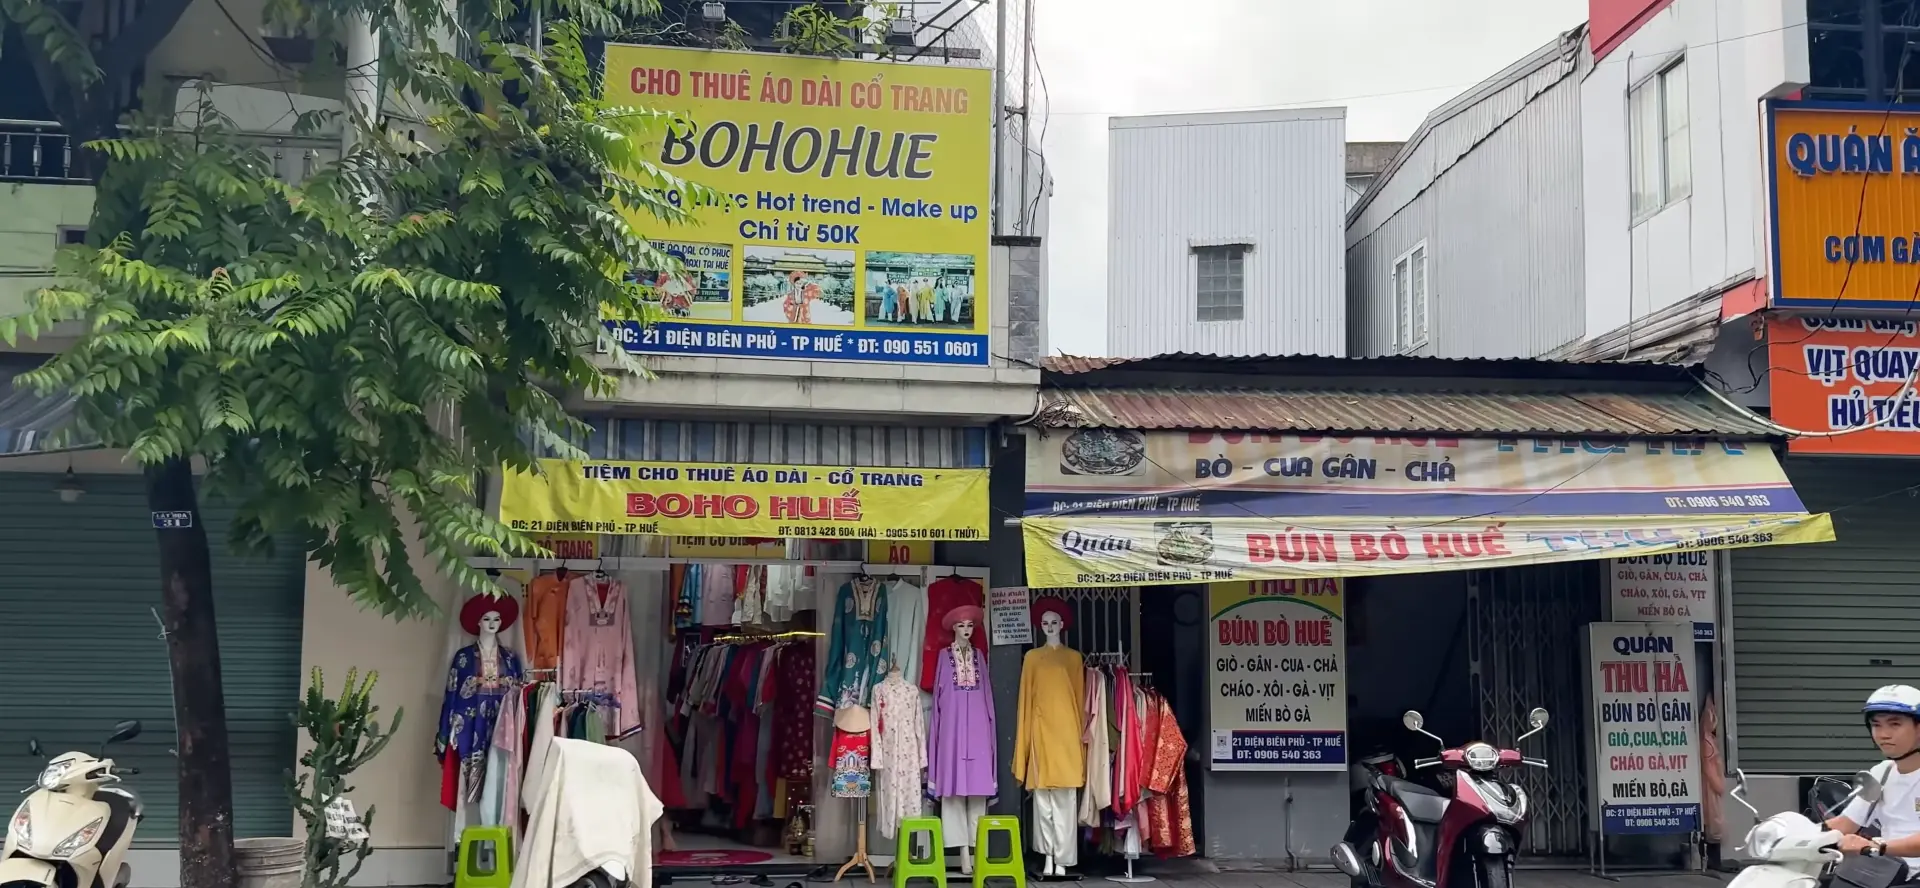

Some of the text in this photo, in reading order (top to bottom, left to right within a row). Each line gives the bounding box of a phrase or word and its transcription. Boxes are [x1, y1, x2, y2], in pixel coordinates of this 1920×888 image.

[630, 66, 969, 115] CHO THUÊ ÁO DÀI CỔ TRANG
[660, 117, 938, 179] BOHOHUE
[1786, 125, 1893, 177] QUÁN
[756, 190, 795, 211] Hot
[802, 193, 861, 215] trend
[882, 197, 942, 219] Make
[950, 204, 978, 223] up
[739, 218, 860, 244] Chỉ từ 50K
[1824, 233, 1885, 263] CƠM
[642, 330, 660, 345] 21
[666, 328, 702, 349] ĐIỆN
[707, 331, 740, 348] BIÊN
[747, 330, 777, 350] PHỦ
[791, 336, 809, 351] TP
[814, 333, 844, 353] HUẾ
[858, 338, 879, 354] ĐT:
[883, 339, 910, 355] 090
[914, 340, 939, 356] 551
[944, 341, 978, 357] 0601
[1807, 349, 1919, 382] VỊT QUAY
[1831, 389, 1866, 426] HỦ
[583, 464, 923, 487] TIỆM CHO THUÊ ÁO DÀI CỔ TRANG
[1195, 453, 1456, 482] BÒ CUA GÂN CHẢ
[626, 487, 863, 521] BOHO HUẾ
[1167, 497, 1178, 512] TP
[1686, 496, 1719, 508] 0906
[1719, 495, 1745, 507] 540
[1745, 494, 1770, 506] 363
[512, 520, 528, 531] ĐC:
[531, 520, 542, 531] 21
[546, 519, 569, 533] ĐIỆN
[571, 519, 593, 531] BIÊN
[625, 523, 636, 532] TP
[640, 521, 658, 533] HUẾ
[778, 526, 792, 535] ĐT:
[794, 526, 817, 536] 0813
[819, 527, 836, 536] 428
[839, 527, 855, 537] 604
[858, 527, 877, 538] (HÀ)
[886, 529, 908, 538] 0905
[910, 529, 927, 538] 510
[930, 530, 945, 538] 601
[555, 540, 593, 560] TRANG
[1062, 522, 1512, 562] Quán BÚN BÒ HUẾ
[1727, 534, 1749, 545] 540
[1752, 532, 1773, 543] 363
[1095, 573, 1121, 583] 21-23
[1200, 571, 1212, 580] TP
[1214, 568, 1233, 579] HUẾ
[1218, 613, 1333, 646] BÚN BÒ HUẾ
[1613, 632, 1674, 655] QUÁN
[1216, 653, 1338, 672] GIÒ GÂN CUA CHẢ
[1600, 653, 1689, 693] THU HÀ
[1220, 679, 1335, 701] CHÁO XÔI GÀ VỊT
[1245, 702, 1311, 722] MIẾN BÒ GÀ
[1602, 698, 1691, 723] BÚN BÒ GÂN
[1232, 734, 1341, 748] 21 ĐIỆN BIÊN PHỦ TP HUẾ
[1236, 750, 1252, 759] ĐT:
[1254, 750, 1279, 759] 0906
[1281, 750, 1300, 759] 540
[1303, 750, 1322, 759] 363
[1610, 752, 1688, 773] CHÁO GÀ,VỊT
[1612, 777, 1688, 798] MIẾN BÒ,GÀ
[1617, 809, 1625, 817] 21
[1676, 808, 1684, 816] TP
[1654, 819, 1667, 827] 540
[1667, 818, 1679, 826] 363
